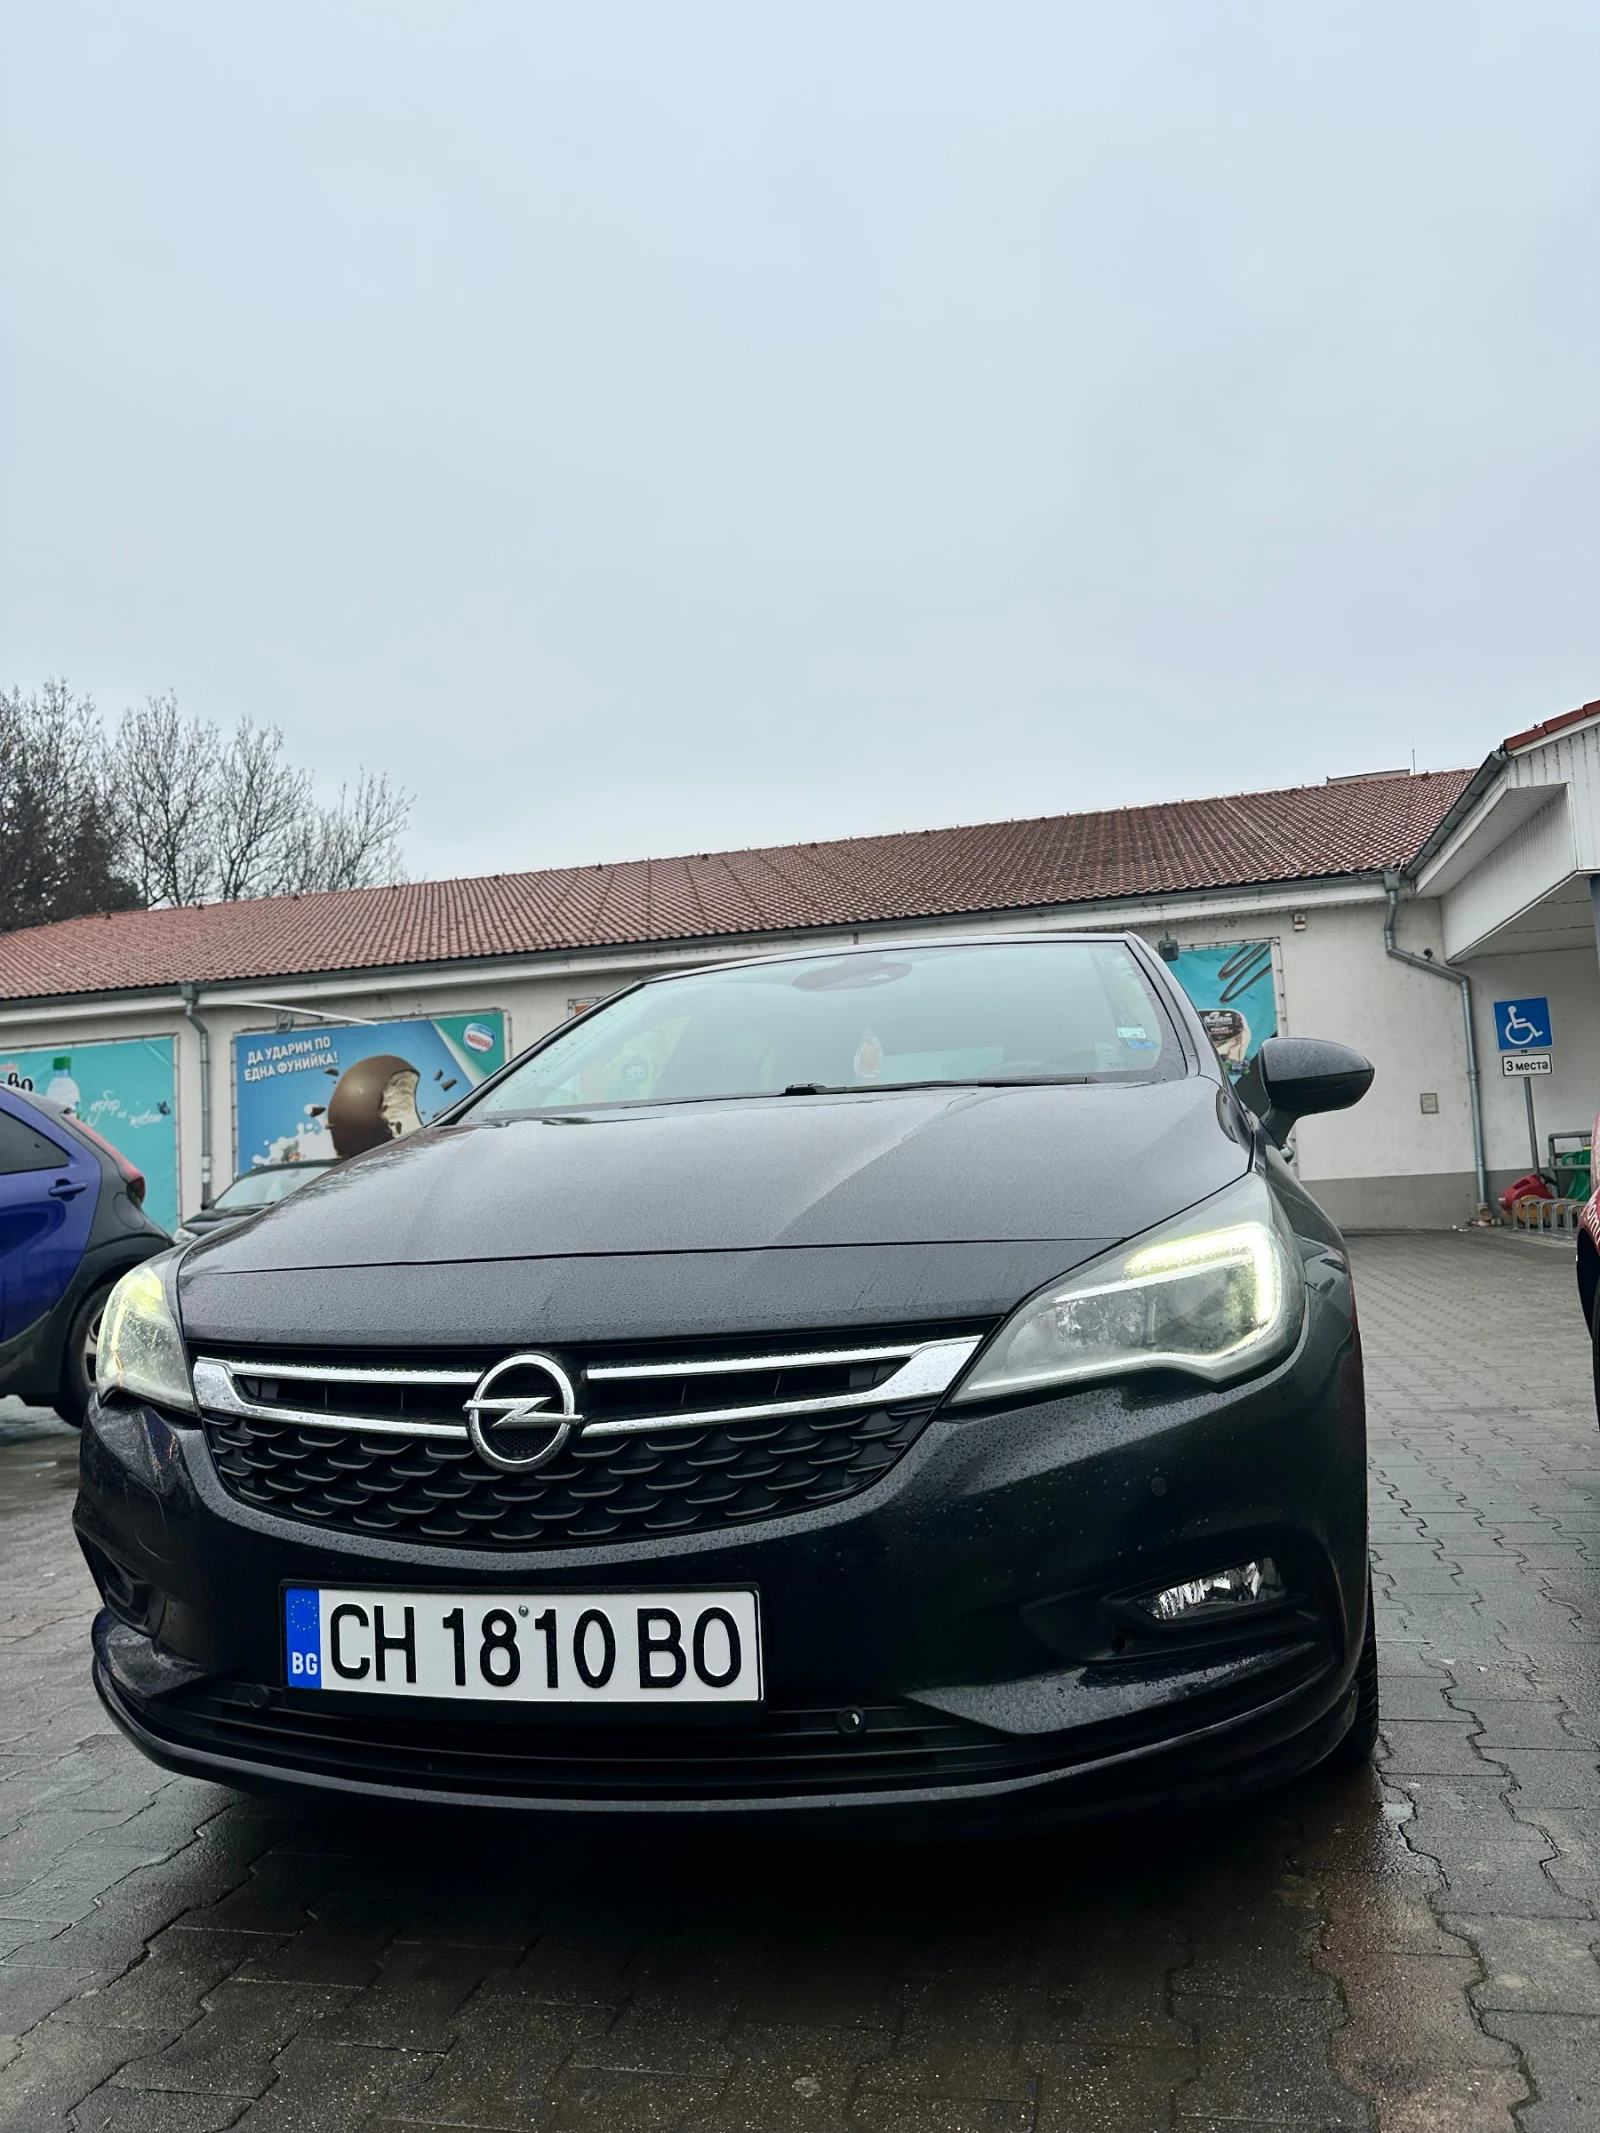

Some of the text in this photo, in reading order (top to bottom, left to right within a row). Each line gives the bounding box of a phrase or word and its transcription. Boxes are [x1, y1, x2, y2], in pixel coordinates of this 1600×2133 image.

[247, 1036, 331, 1066] ДА УДАРИМ ПО
[1506, 1060, 1549, 1072] 3 места
[244, 1051, 338, 1082] ЕДНА ФУНИЙКА!
[330, 1603, 742, 1689] CH 1810 BO
[291, 1651, 318, 1676] BG
